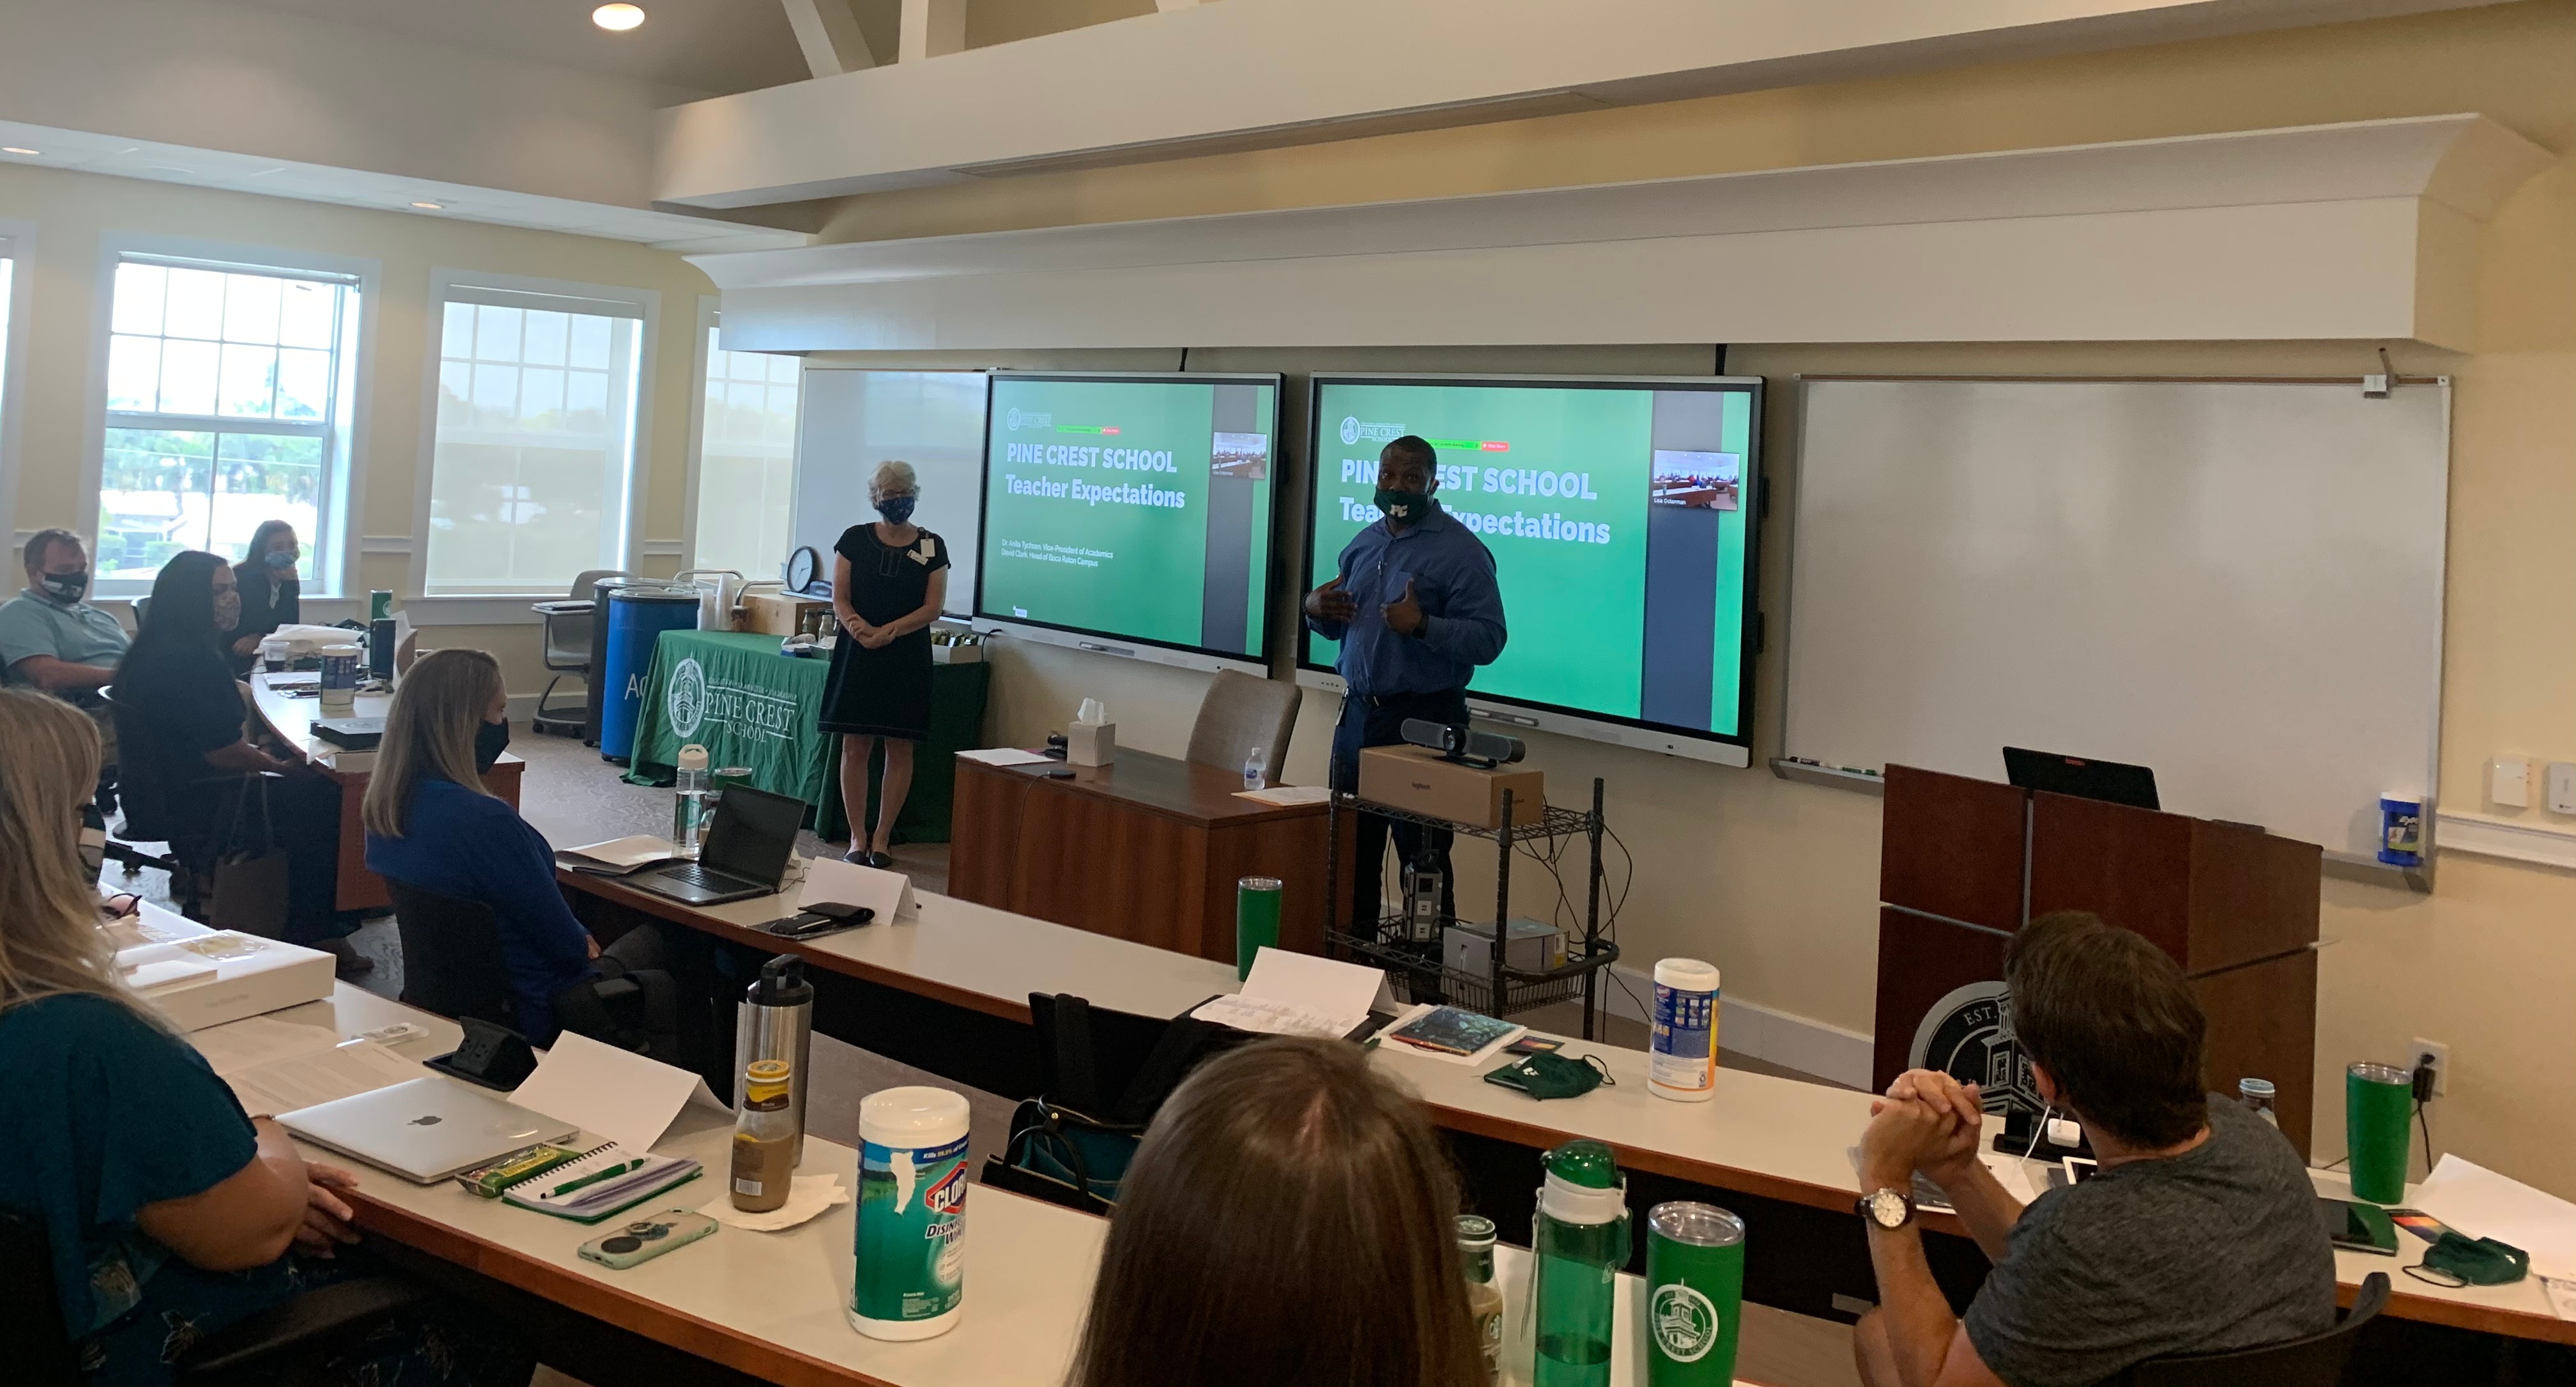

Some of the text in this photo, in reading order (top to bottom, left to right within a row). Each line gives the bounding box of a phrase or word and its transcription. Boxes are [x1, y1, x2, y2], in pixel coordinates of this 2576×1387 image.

[1360, 427, 1406, 438] PINE CREST
[1007, 443, 1177, 473] PINE CREST SCHOOL
[1005, 473, 1186, 509] Teacher Expectations
[1341, 459, 1597, 500] PIN EST SCHOOL
[1001, 548, 1015, 556] David
[1048, 553, 1061, 562] Boca
[1061, 555, 1077, 564] Raton
[1077, 557, 1098, 567] Campus
[1085, 548, 1114, 559] Academics
[705, 691, 743, 719] PINE
[745, 700, 795, 732] CREST
[726, 720, 767, 743] SCHOOL
[1963, 1007, 1998, 1026] EST.
[934, 1173, 967, 1213] CLOR
